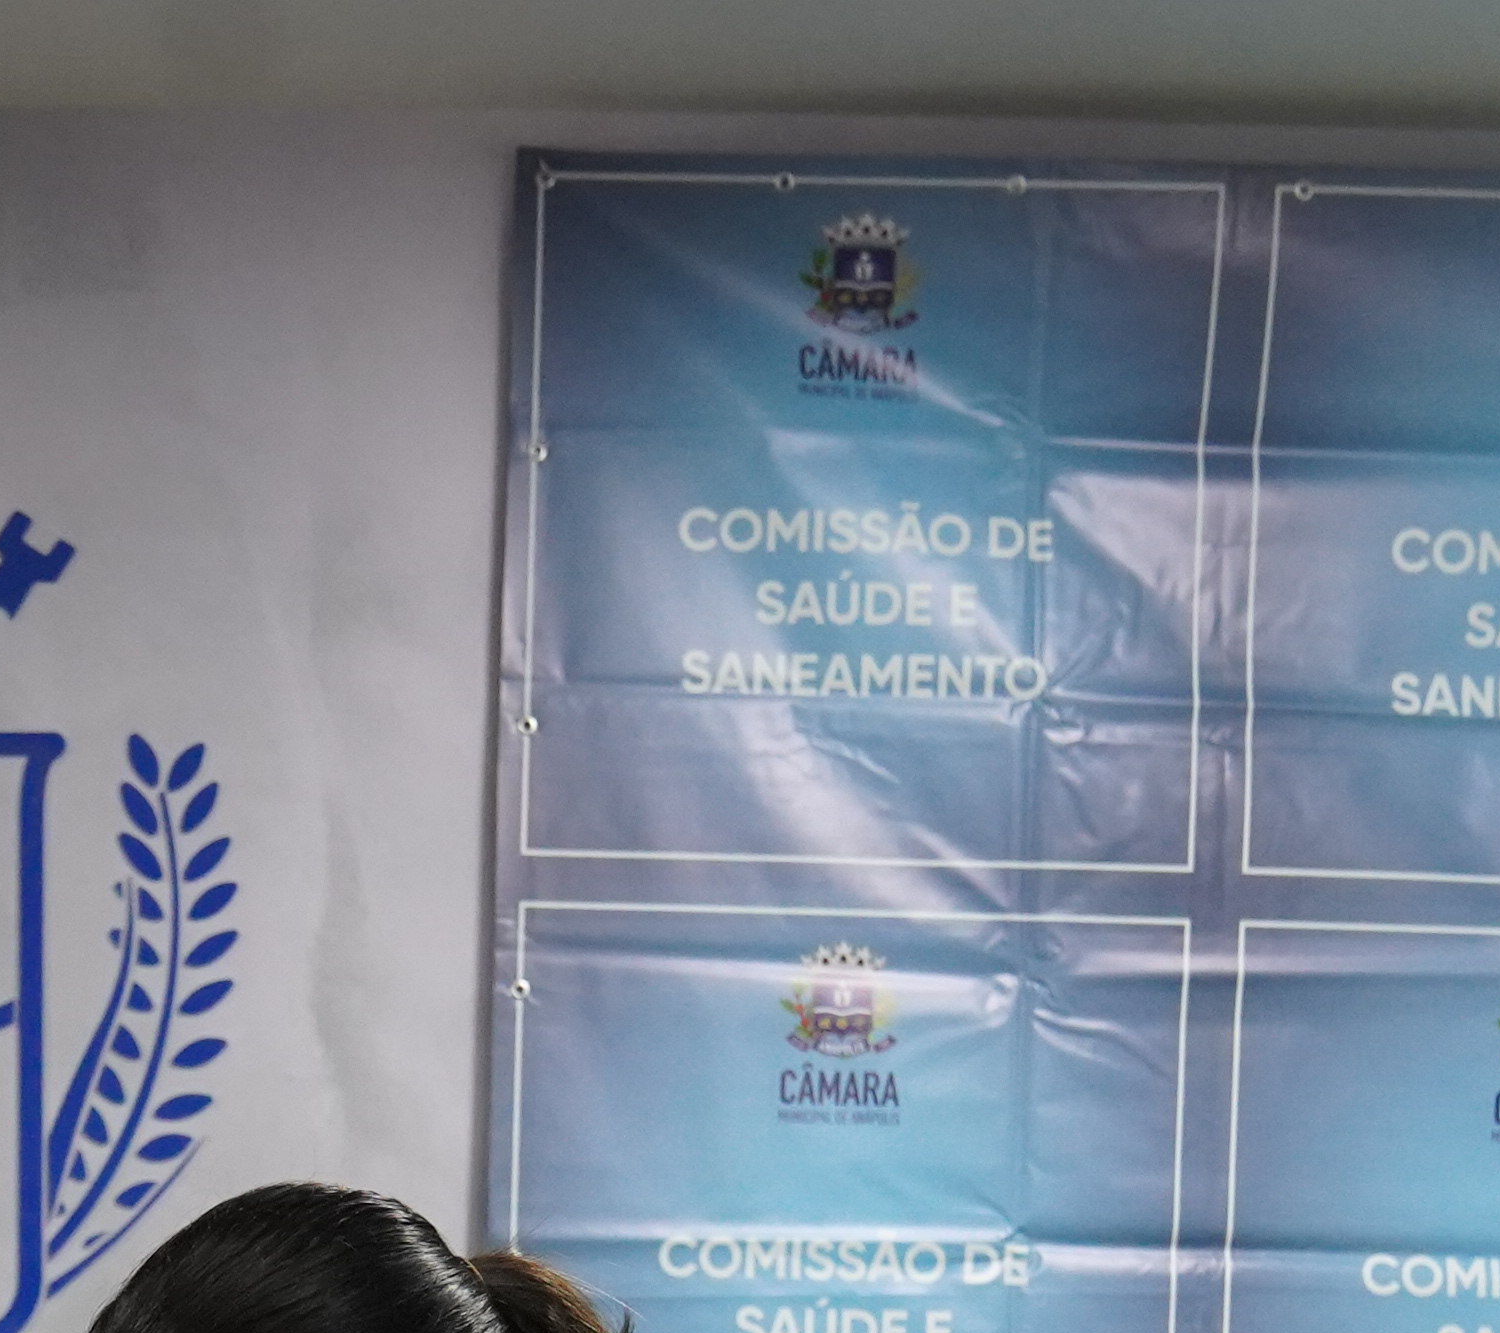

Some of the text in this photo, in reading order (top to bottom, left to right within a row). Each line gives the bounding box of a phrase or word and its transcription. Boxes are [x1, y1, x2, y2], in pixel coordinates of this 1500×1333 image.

[678, 502, 1055, 562] COMISSÃO DE
[756, 570, 980, 629] SAÚDE E
[680, 650, 1048, 702] SANEAMENTO
[779, 1063, 901, 1107] CÂMARA
[961, 1241, 1031, 1288] DE
